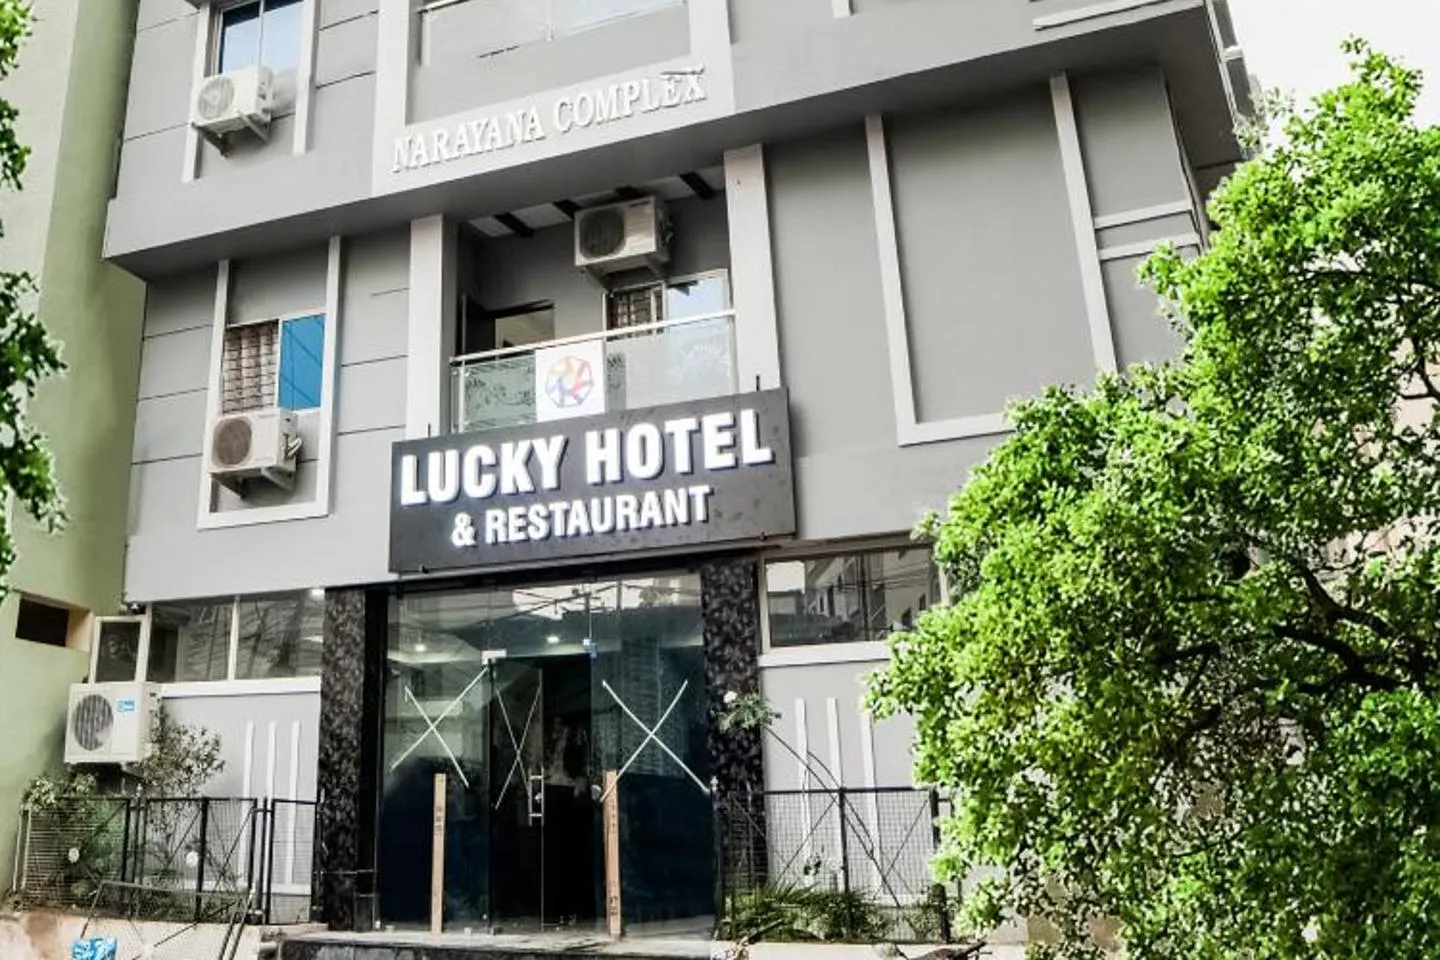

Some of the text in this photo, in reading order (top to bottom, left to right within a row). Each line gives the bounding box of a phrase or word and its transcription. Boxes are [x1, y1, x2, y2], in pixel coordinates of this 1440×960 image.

[392, 71, 706, 172] NARAYANA COMPLEX
[400, 408, 773, 507] LUCKY HOTEL
[451, 484, 713, 547] & RESTAURANT
